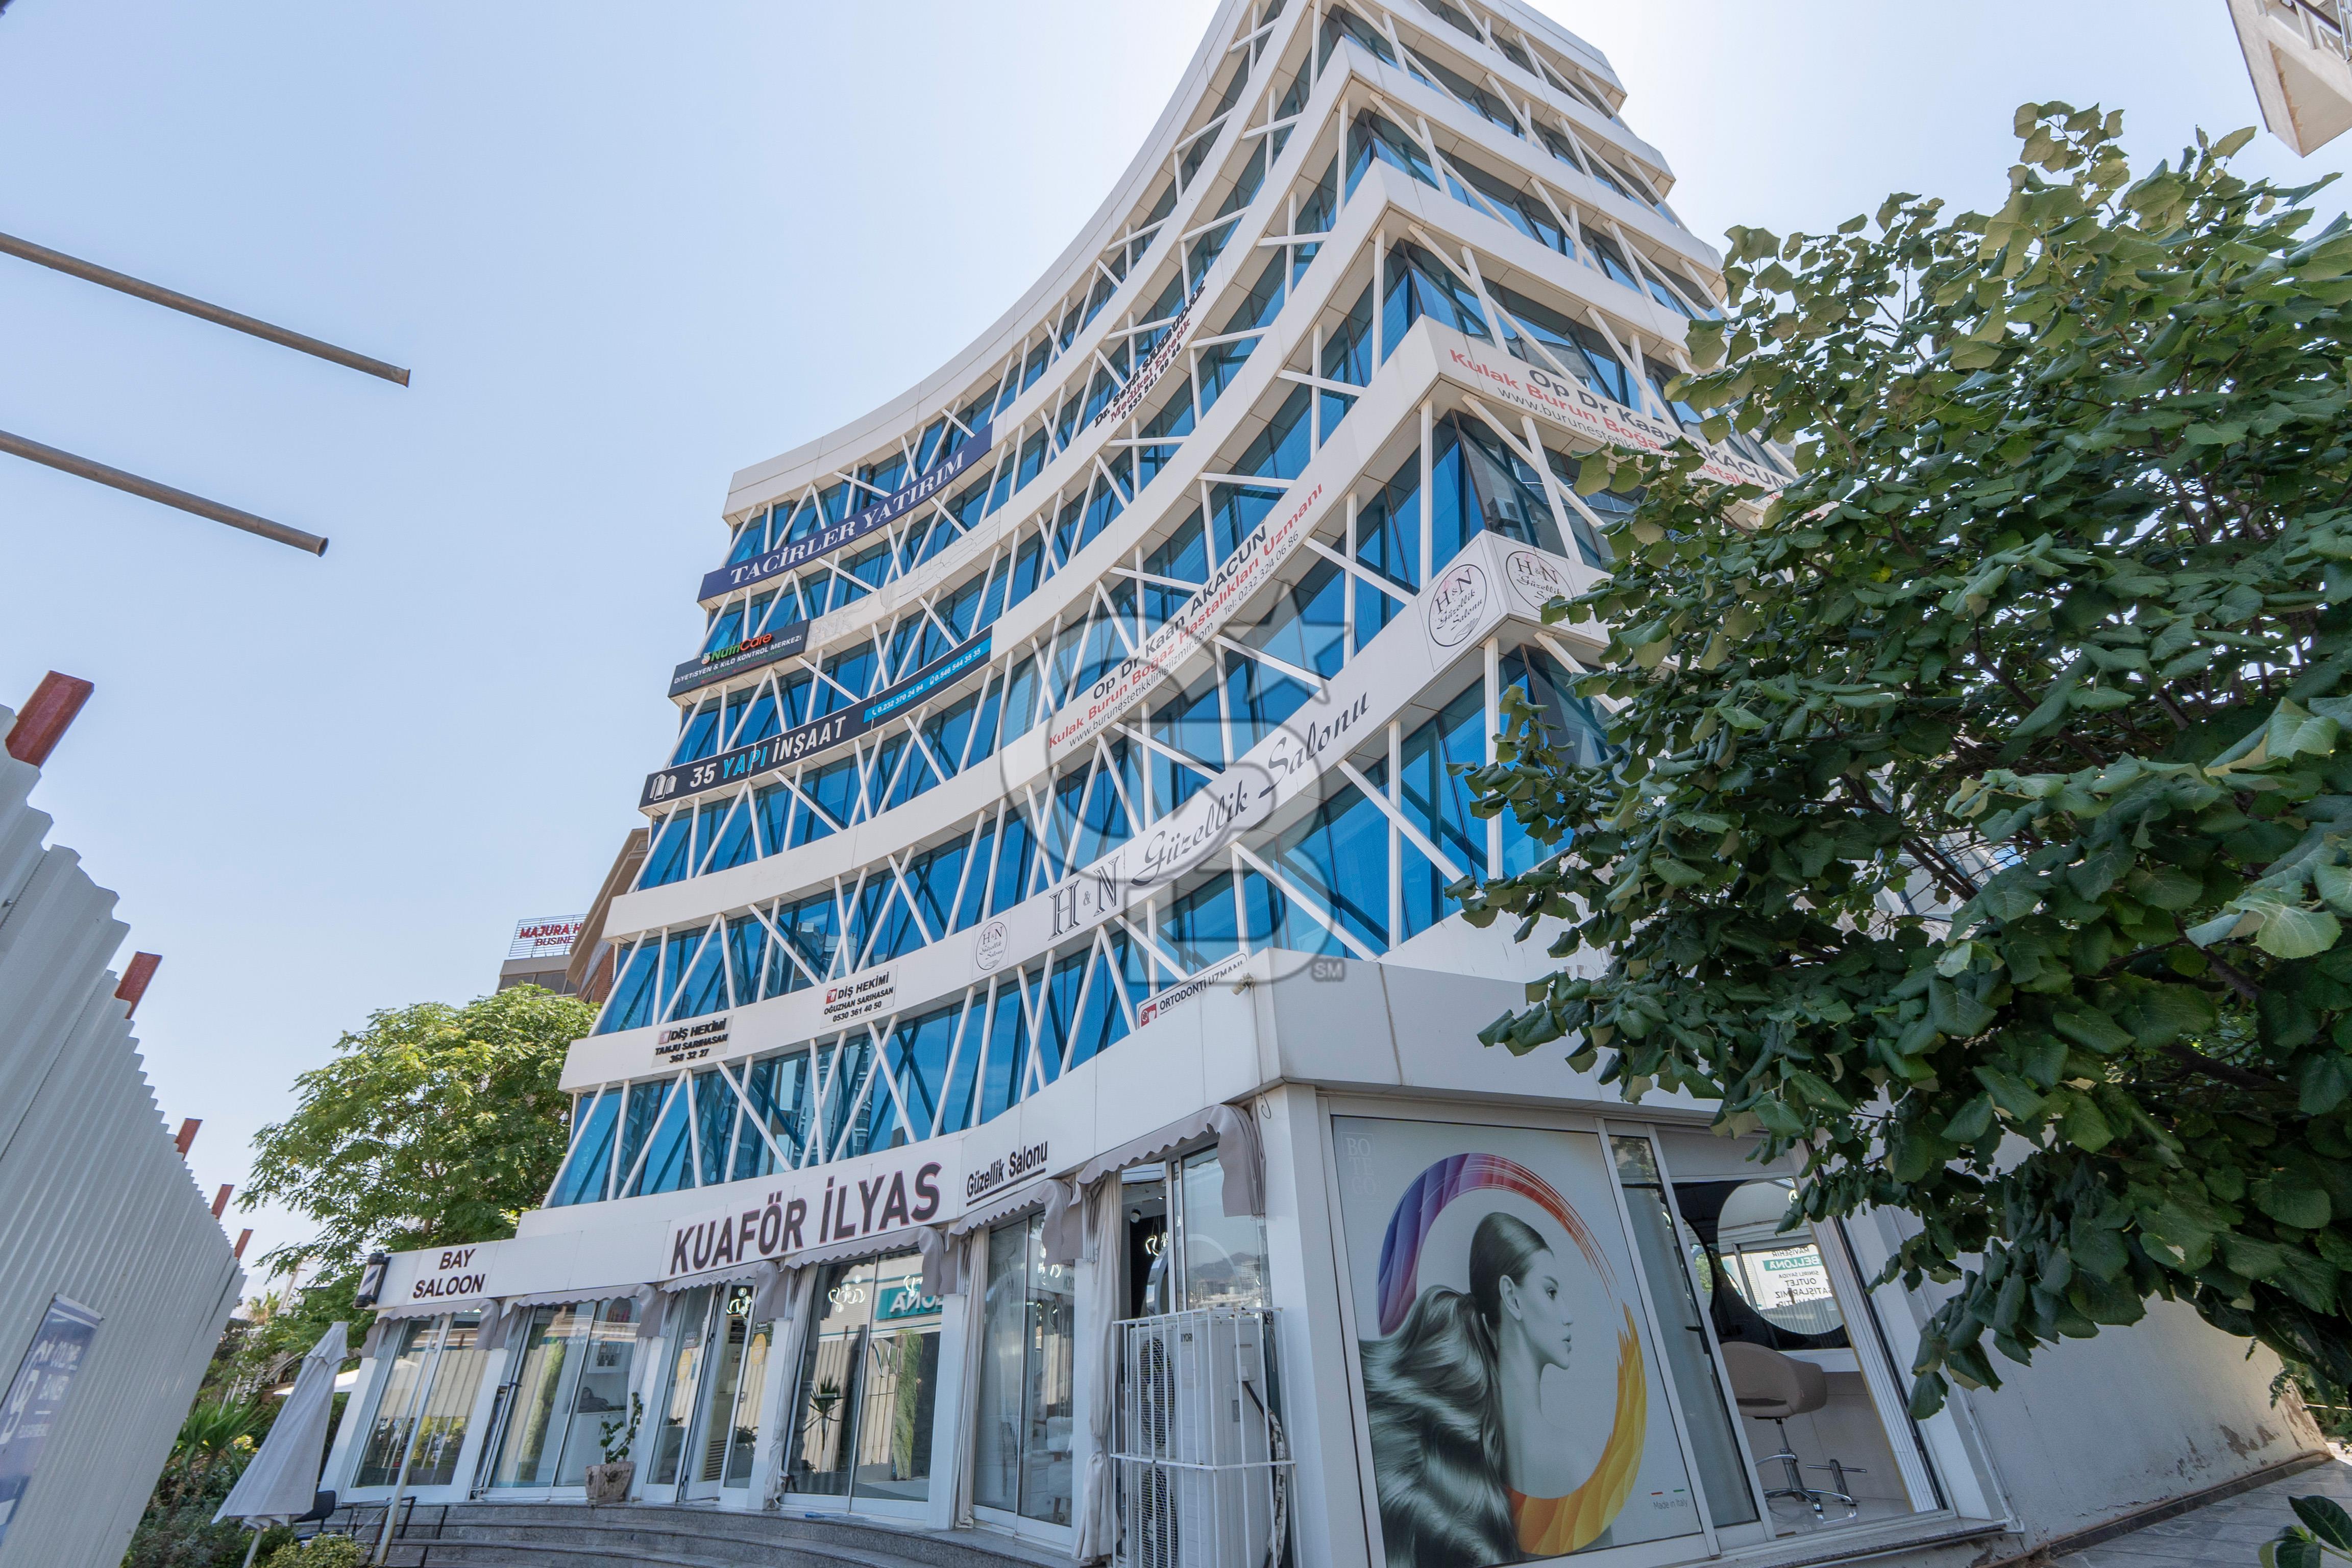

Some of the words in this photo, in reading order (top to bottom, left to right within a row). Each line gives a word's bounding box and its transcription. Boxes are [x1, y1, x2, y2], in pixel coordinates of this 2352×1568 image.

[1110, 369, 1153, 423] Medikal
[1155, 318, 1190, 370] Estetik
[1128, 394, 1142, 415] 533
[1144, 374, 1158, 394] 541
[1160, 360, 1169, 374] 99
[1450, 349, 1521, 390] Kulak
[1526, 383, 1598, 424] Burun
[1603, 416, 1672, 456] Boğa
[1529, 370, 1570, 397] Op
[1577, 389, 1609, 414] Dr
[731, 521, 855, 585] TACİRLER
[862, 450, 964, 528] YATIRIM
[1224, 599, 1237, 616] Tel:
[1238, 576, 1258, 601] 0232
[1260, 557, 1275, 579] 324
[1276, 547, 1287, 560] 06
[1288, 530, 1298, 547] 86
[1049, 718, 1084, 748] Kulak
[1088, 684, 1128, 721] Burun
[1132, 643, 1174, 685] Boğaz
[1179, 557, 1259, 645] Hastalıkları
[1263, 483, 1322, 556] Uzmanı
[1093, 677, 1115, 700] Op
[1122, 656, 1140, 678] Dr
[1145, 616, 1185, 658] Kaan
[1190, 525, 1266, 618] AKACUN
[1436, 588, 1476, 629] Güzellik
[1451, 599, 1483, 631] Salonu
[710, 633, 772, 662] NutriCare
[738, 647, 769, 663] KONTROL
[877, 700, 894, 713] 0.232
[895, 694, 906, 704] 370
[907, 690, 915, 698] 24
[964, 653, 972, 663] 35
[972, 647, 981, 657] 35
[690, 762, 717, 788] 35
[722, 746, 768, 779] YAPI
[772, 716, 846, 763] İNŞAAT
[1131, 779, 1249, 887] Güzellik
[1258, 692, 1369, 799] Salonu
[519, 924, 570, 939] MAJURA
[824, 999, 855, 1015] OĞUZHAN
[856, 986, 894, 1005] SARIHASAN
[838, 986, 853, 999] DİŞ
[855, 971, 889, 994] HEKİMİ
[1160, 976, 1207, 1010] ORTODONTİ
[670, 1027, 689, 1041] DİŞ
[690, 1017, 727, 1037] HEKİMİ
[832, 1012, 849, 1022] 0530
[850, 1007, 862, 1017] 361
[864, 1004, 872, 1012] 40
[873, 1000, 882, 1010] 50
[655, 1043, 681, 1056] TANJU
[967, 1158, 1004, 1198] Güzellik
[1009, 1140, 1048, 1178] Salonu
[670, 1190, 807, 1276] KUAFÖR
[819, 1161, 943, 1244] İLYAS
[439, 1248, 476, 1270] BAY
[412, 1273, 486, 1299] SALOON
